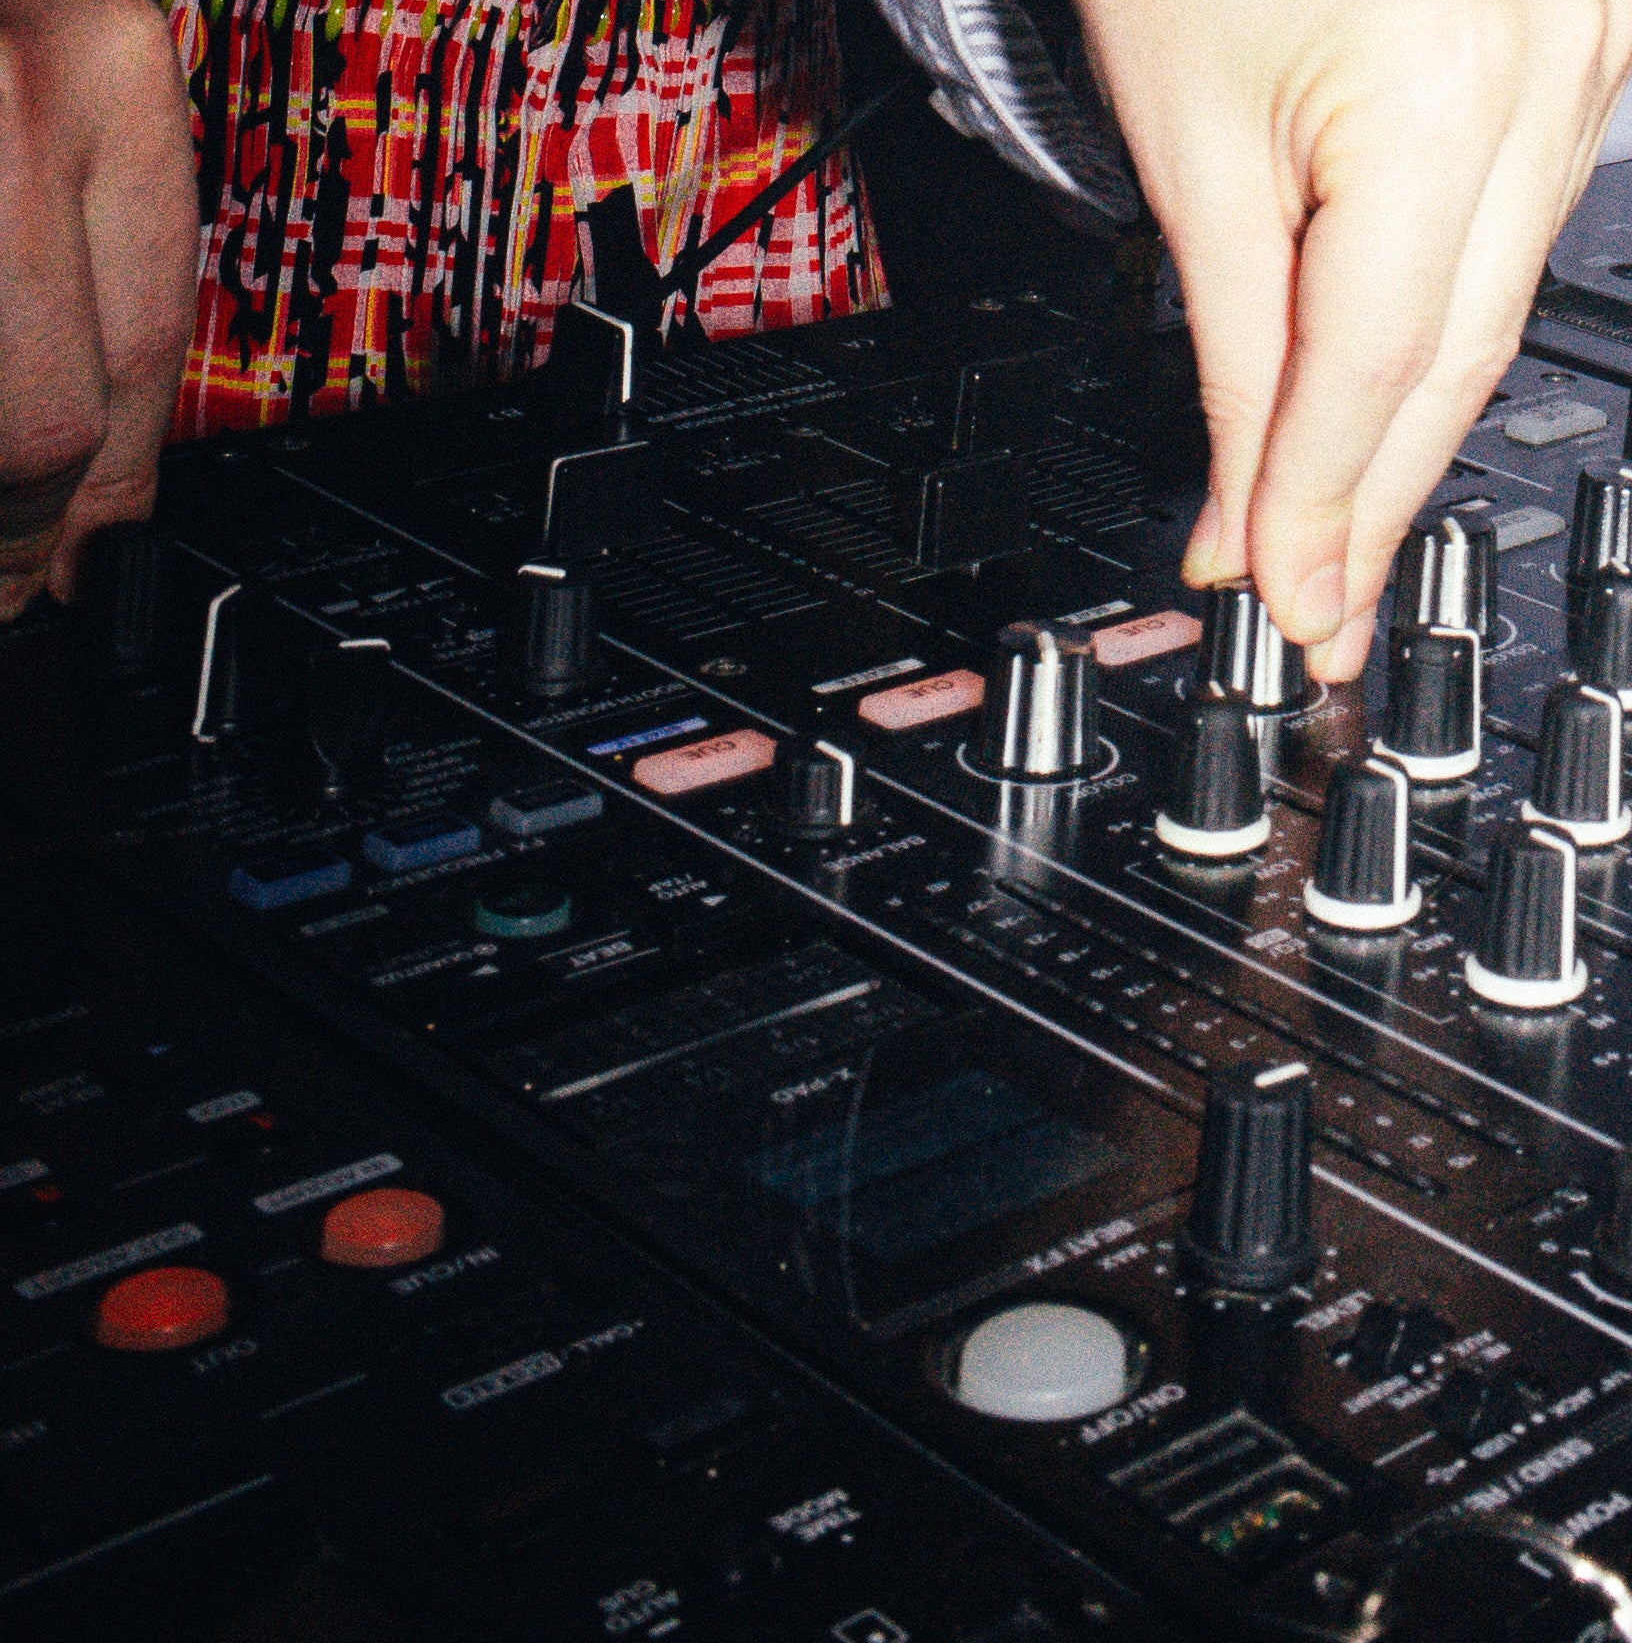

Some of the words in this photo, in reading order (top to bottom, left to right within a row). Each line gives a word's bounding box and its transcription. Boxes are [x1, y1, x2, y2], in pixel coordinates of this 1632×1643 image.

[1118, 619, 1165, 638] CUE
[909, 678, 955, 699] CUE
[683, 738, 737, 760] CUE
